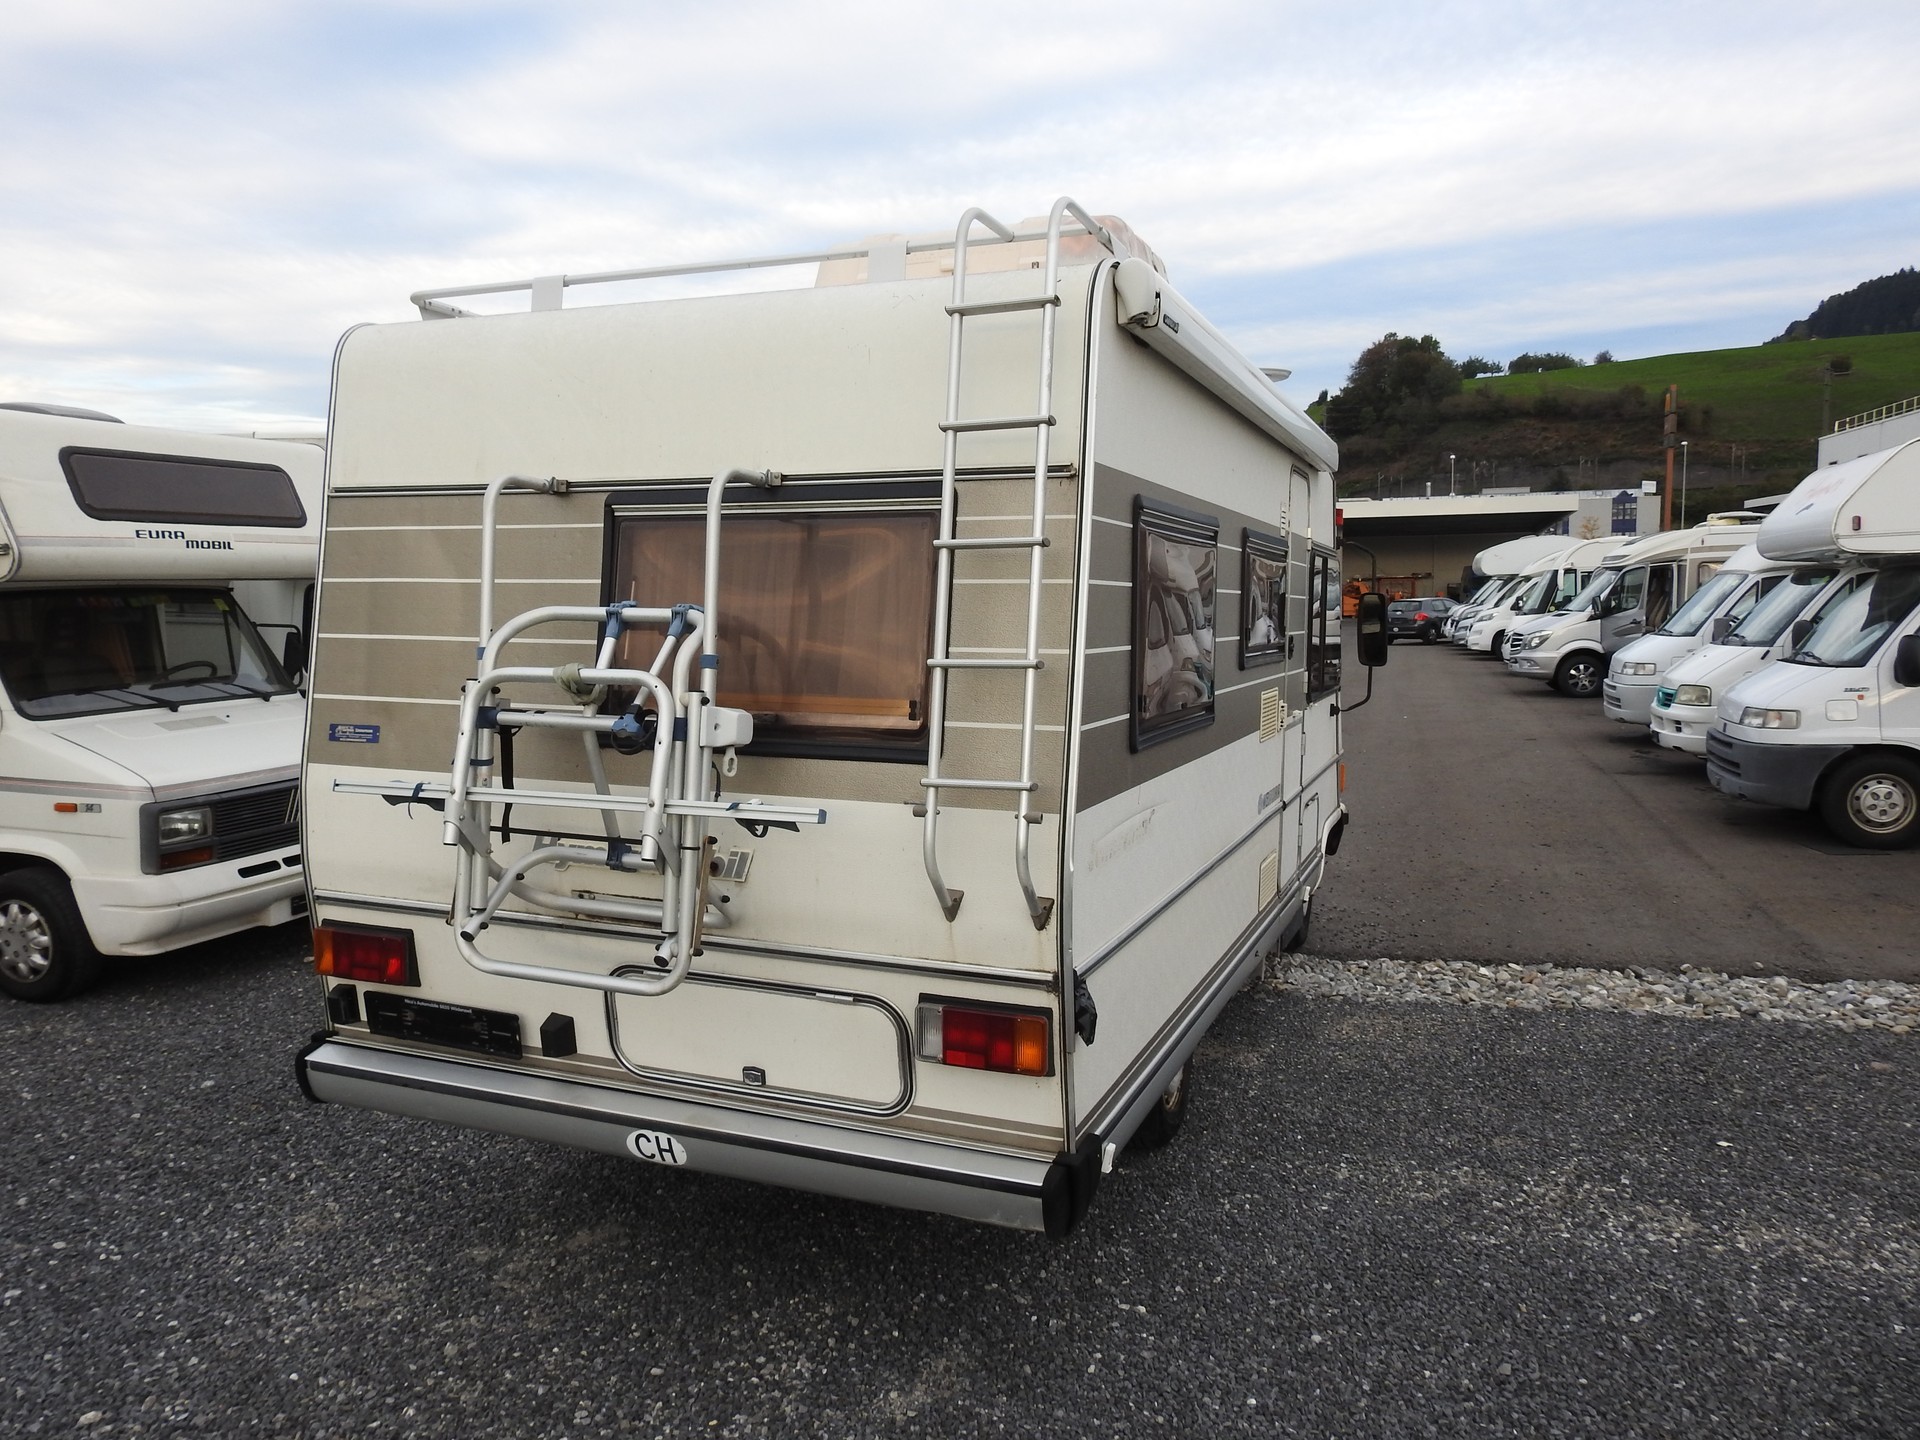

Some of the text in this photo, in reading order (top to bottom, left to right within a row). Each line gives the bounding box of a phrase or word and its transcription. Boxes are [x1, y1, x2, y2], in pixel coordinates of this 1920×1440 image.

[135, 529, 185, 540] EURA
[185, 540, 234, 550] MOBIL
[634, 1133, 678, 1164] CH
